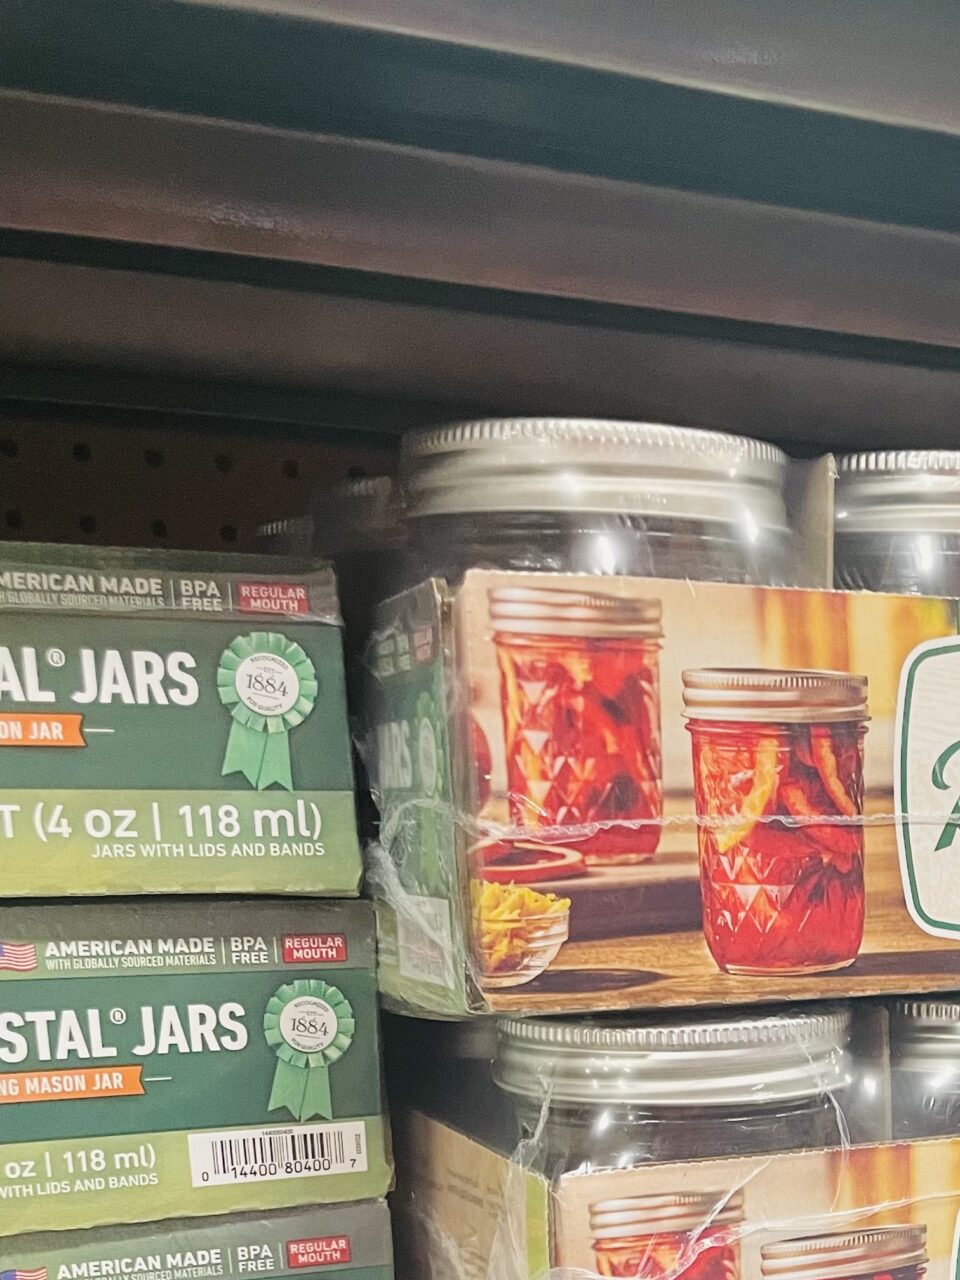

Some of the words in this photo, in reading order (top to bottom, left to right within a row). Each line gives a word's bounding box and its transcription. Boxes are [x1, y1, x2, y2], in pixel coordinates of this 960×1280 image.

[101, 576, 163, 595] MADE
[180, 580, 221, 597] BPA
[241, 586, 305, 600] REGULAR
[181, 598, 223, 611] FREE
[251, 600, 298, 611] MOUTH
[71, 648, 200, 706] JARS
[246, 673, 288, 697] 1884
[29, 721, 64, 740] JAR
[33, 802, 72, 842] (4
[84, 808, 138, 838] oz
[179, 804, 241, 838] 118
[254, 799, 322, 840] ml)
[91, 844, 136, 858] JARS
[139, 844, 184, 857] WITH
[189, 843, 227, 857] LIDS
[231, 843, 265, 857] AND
[270, 843, 325, 857] BANDS
[45, 939, 152, 957] AMERICAN
[158, 937, 216, 954] MADE
[230, 936, 267, 952] BPA
[285, 936, 343, 949] REGULAR
[231, 951, 269, 964] FREE
[292, 948, 337, 960] MOUTH
[132, 1002, 248, 1056] JARS
[290, 1017, 329, 1036] 1884
[25, 1075, 87, 1095] MASON
[92, 1072, 124, 1091] JAR
[5, 1161, 36, 1178] oz
[63, 1149, 106, 1173] 118
[114, 1144, 156, 1169] ml)
[231, 1163, 277, 1179] 14400
[285, 1158, 332, 1174] 80400
[37, 1181, 70, 1195] LIDS
[74, 1178, 105, 1192] AND
[108, 1173, 158, 1189] BANDS
[237, 1244, 273, 1260] BPA
[290, 1240, 346, 1254] REGULAR
[56, 1255, 161, 1280] AMERICAN
[167, 1249, 222, 1268] MADE
[298, 1250, 341, 1263] MOUTH
[174, 1265, 223, 1280] MATERIALS
[238, 1259, 274, 1273] FREE
